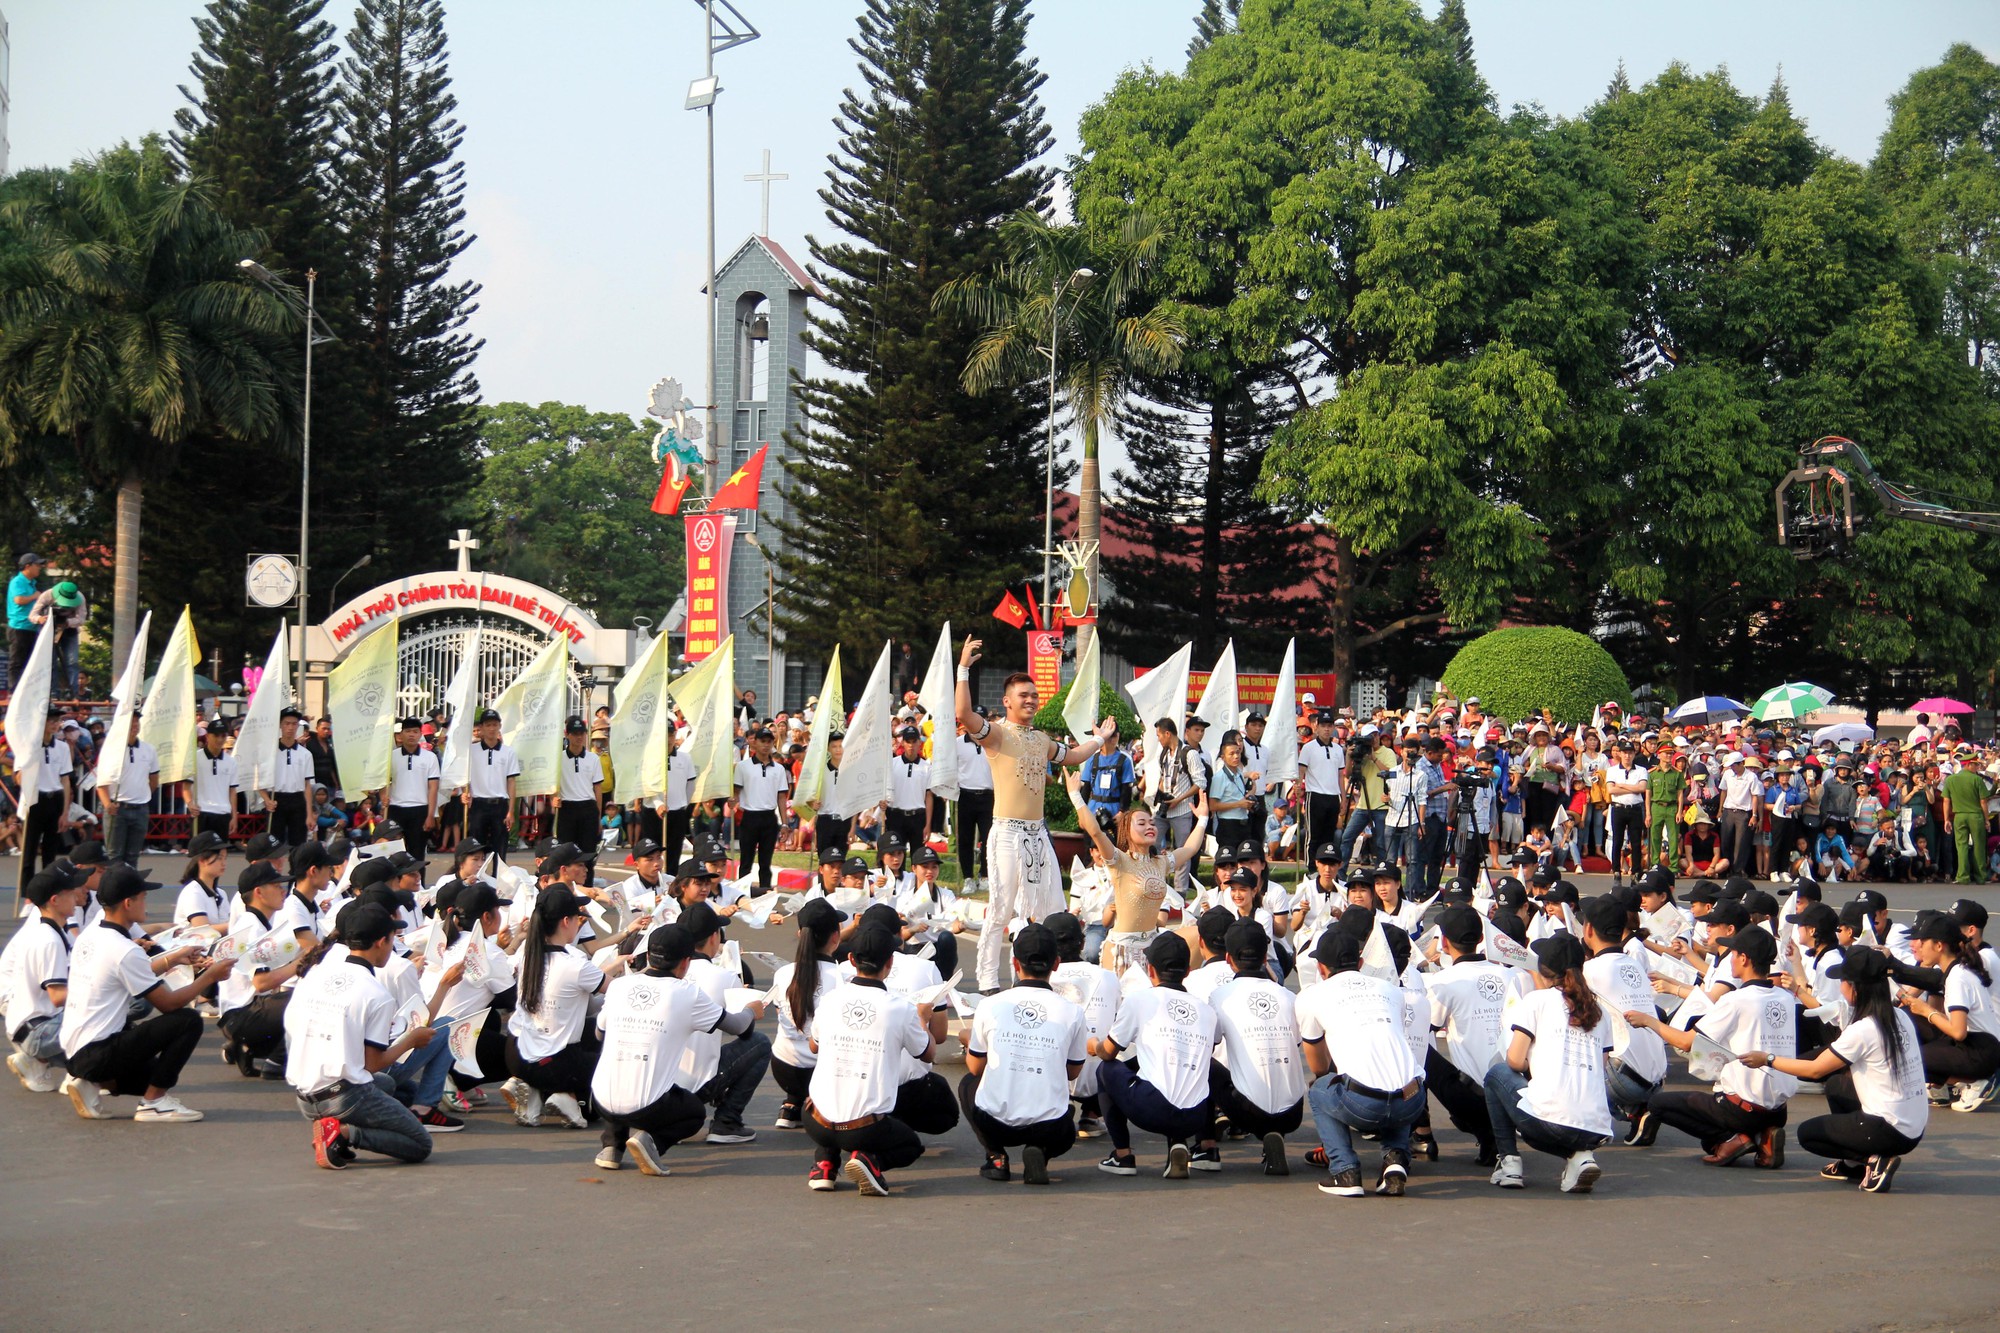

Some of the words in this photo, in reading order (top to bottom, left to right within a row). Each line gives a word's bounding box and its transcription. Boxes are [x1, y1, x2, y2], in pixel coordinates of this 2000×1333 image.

[333, 610, 365, 642] NHÀ
[363, 592, 395, 620] THỜ
[398, 582, 446, 606] CHÍNH
[448, 578, 478, 600] TÒA
[480, 586, 512, 603] BAN
[512, 596, 538, 613] MÊ
